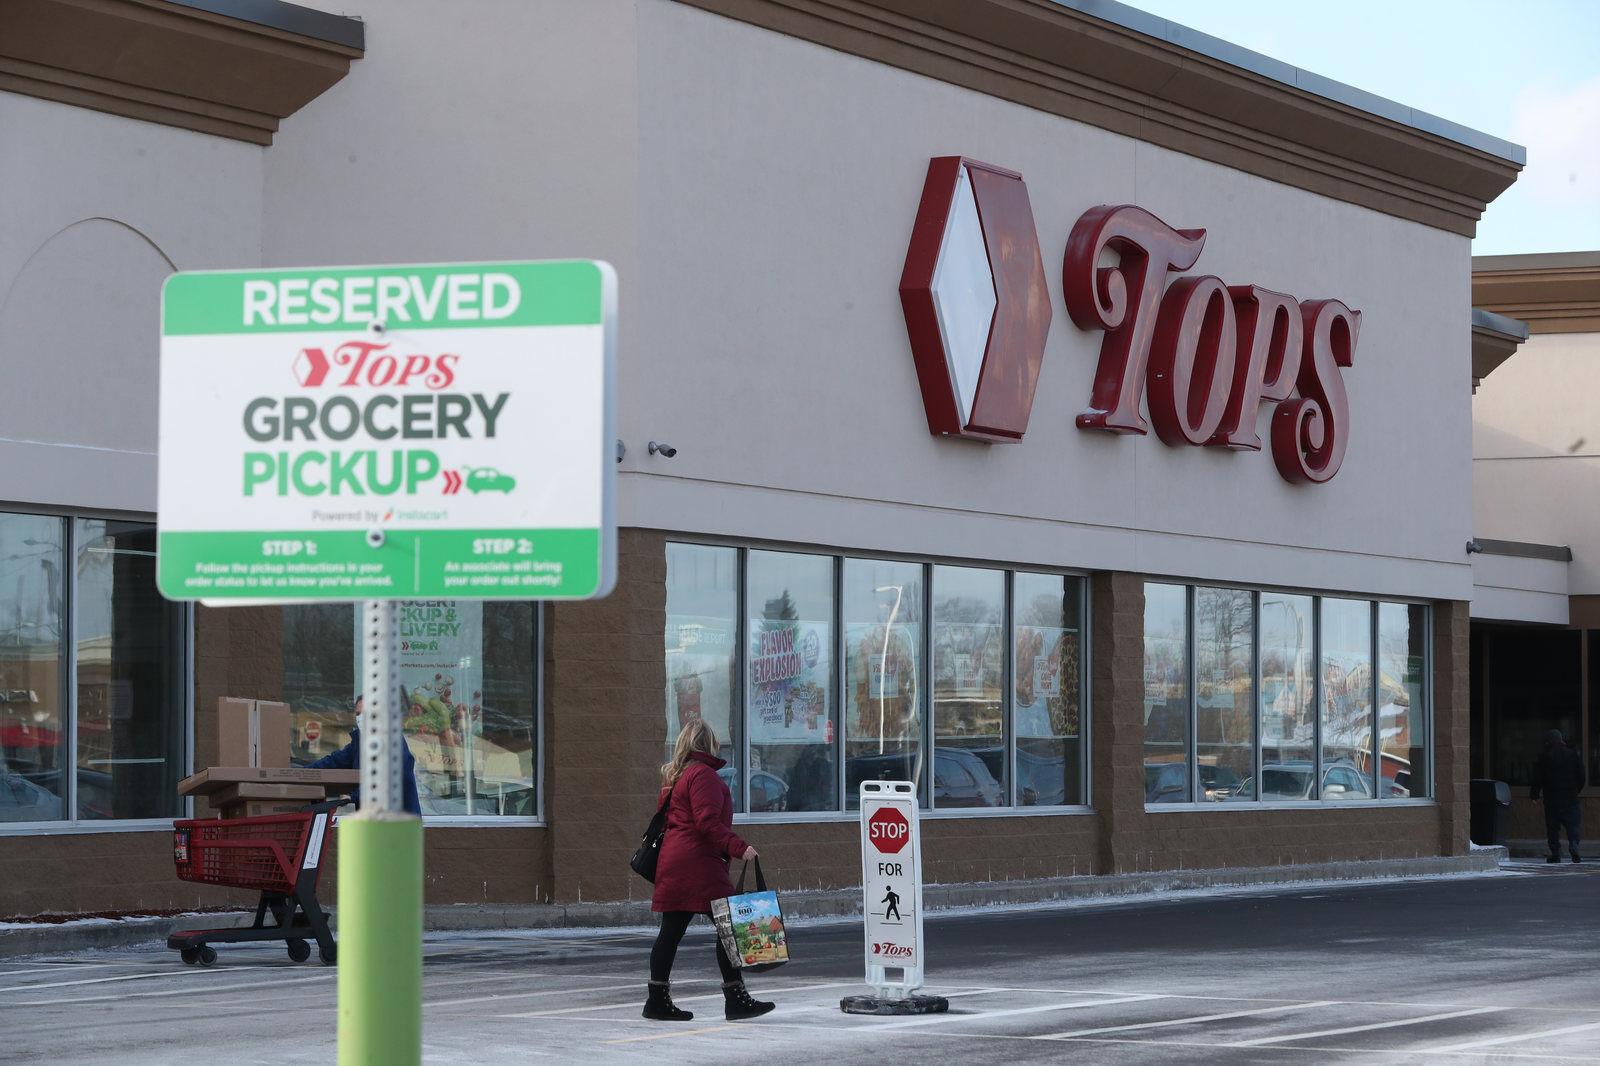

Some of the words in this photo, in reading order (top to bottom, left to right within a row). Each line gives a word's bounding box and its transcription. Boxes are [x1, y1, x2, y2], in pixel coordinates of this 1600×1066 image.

[243, 273, 521, 326] RESERVED
[243, 392, 510, 441] GROCERY
[243, 449, 440, 496] PICKUP
[312, 510, 362, 521] Powered
[364, 510, 378, 522] by
[262, 540, 303, 556] STEP
[473, 538, 515, 554] STEP
[517, 538, 533, 554] 2:
[196, 562, 229, 574] Follow
[232, 562, 248, 574] the
[250, 562, 284, 576] pickup
[287, 562, 345, 573] instructions
[347, 562, 358, 573] in
[360, 563, 383, 575] your
[462, 562, 510, 572] associate
[512, 561, 531, 572] will
[533, 561, 562, 574] bring
[185, 576, 213, 587] order
[215, 576, 245, 587] status
[247, 576, 258, 586] to
[260, 576, 274, 586] let
[289, 575, 316, 586] know
[444, 576, 468, 588] your
[470, 575, 499, 586] order
[502, 575, 519, 586] out
[401, 608, 442, 622] KUP
[446, 608, 457, 622] &
[400, 623, 461, 637] LIVERY
[761, 629, 794, 656] FLAVOR
[753, 652, 802, 683] EXPLOSION
[871, 822, 908, 839] STOP
[878, 862, 902, 877] FOR
